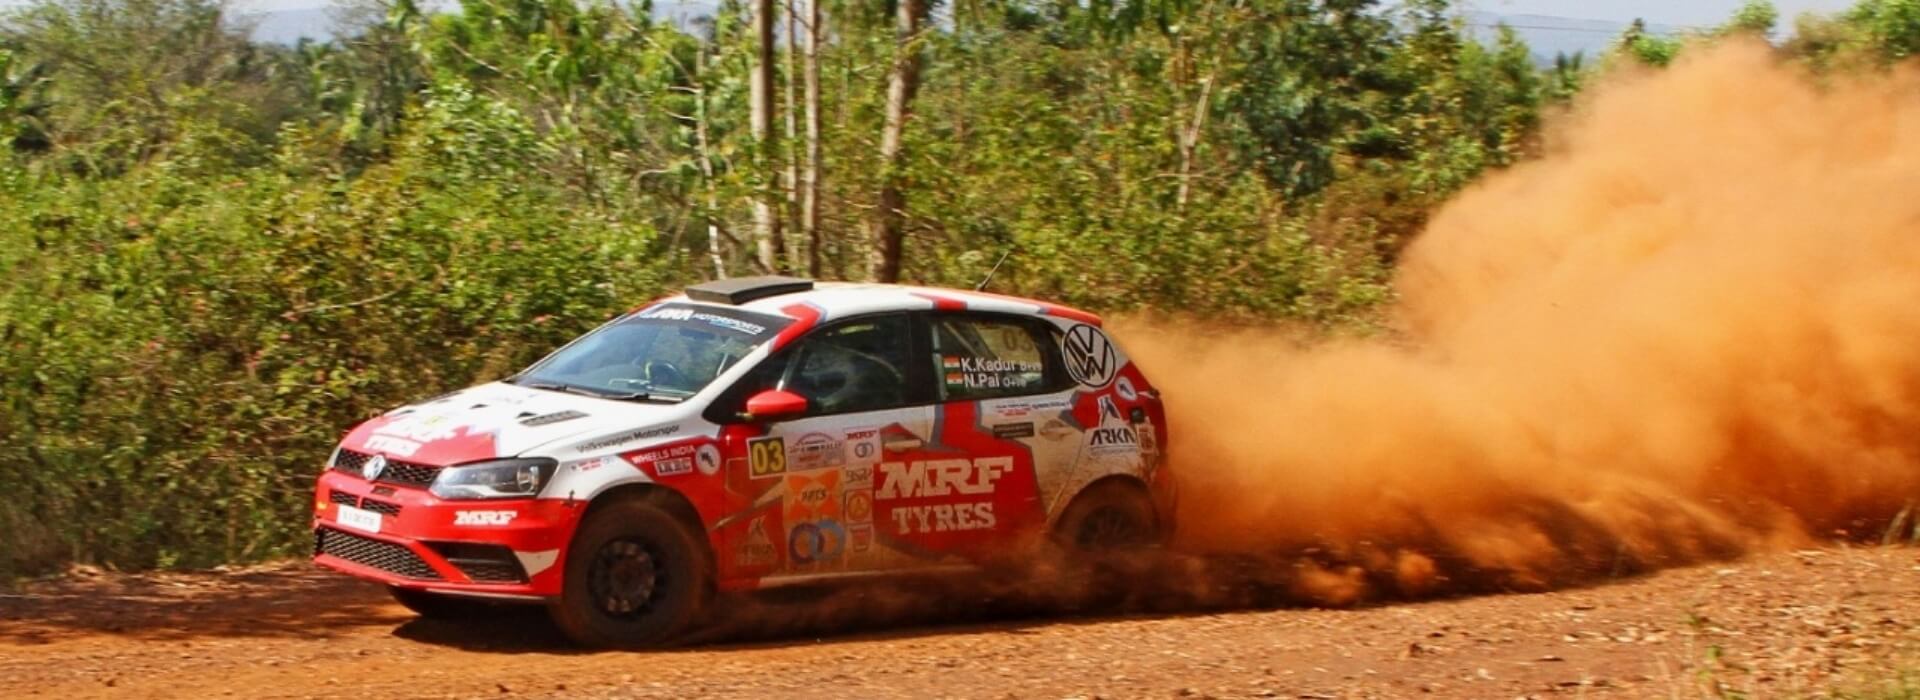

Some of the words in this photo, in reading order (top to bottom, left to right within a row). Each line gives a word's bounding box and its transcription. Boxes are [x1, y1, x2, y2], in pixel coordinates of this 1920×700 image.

[961, 357, 1015, 372] K.Kadur
[963, 372, 1000, 388] N.Pai
[1090, 428, 1136, 446] ARKA
[631, 450, 669, 464] WHEELS
[670, 445, 696, 457] INDIA
[751, 440, 785, 474] 03
[875, 456, 1014, 499] MRF
[454, 510, 518, 526] MRF
[892, 502, 997, 535] TYRES
